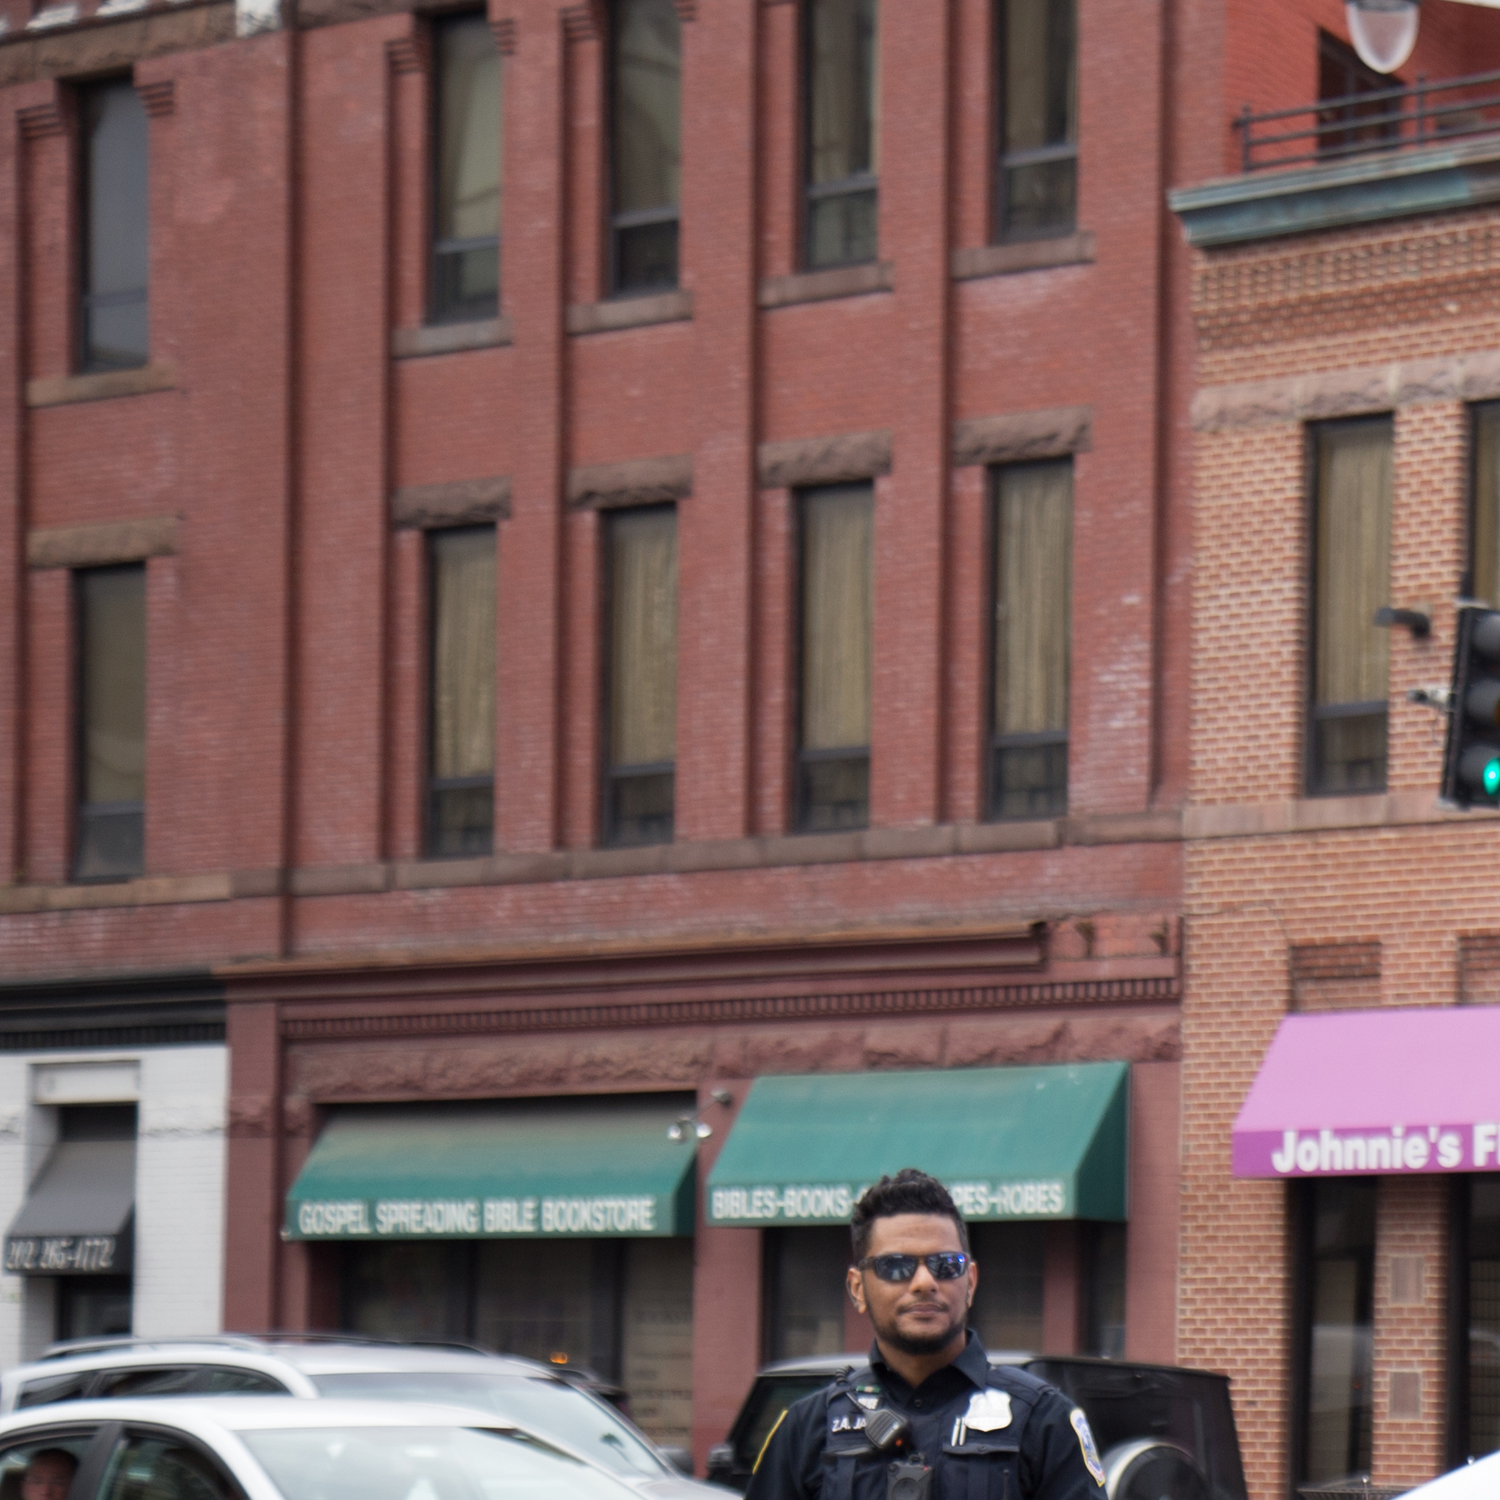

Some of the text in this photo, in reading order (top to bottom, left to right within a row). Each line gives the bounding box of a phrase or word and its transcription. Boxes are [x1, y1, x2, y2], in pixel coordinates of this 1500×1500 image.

[1271, 1125, 1462, 1173] Johnnie's
[300, 1196, 657, 1235] GOSPEL SPREADING BIBLE BOOKSTORE
